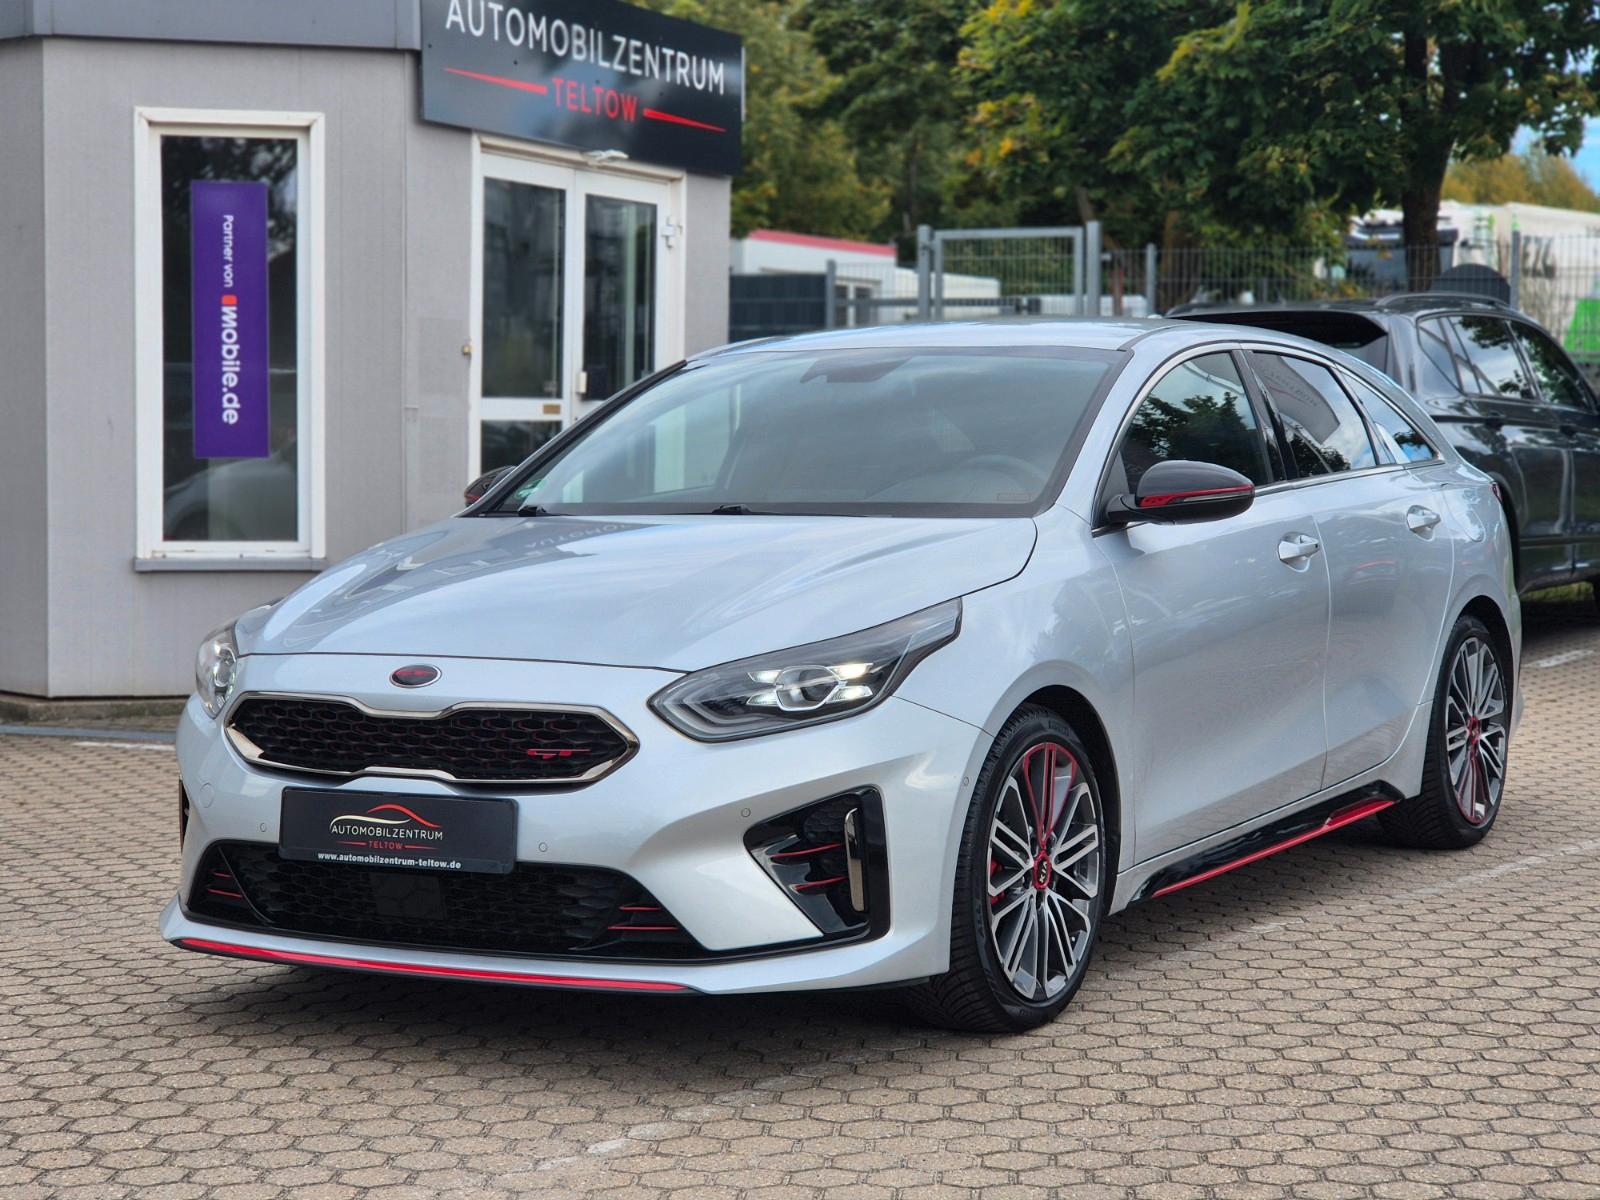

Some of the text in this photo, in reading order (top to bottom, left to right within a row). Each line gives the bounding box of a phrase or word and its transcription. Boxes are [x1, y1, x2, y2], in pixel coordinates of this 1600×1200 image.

[446, 0, 725, 95] AUTOMOBILZENTRUM
[552, 76, 639, 123] TELTOW
[222, 214, 235, 288] Partner von
[221, 306, 241, 425] mobile.de
[331, 825, 443, 841] AUTOMOBILZENTRUM
[368, 840, 403, 850] TELTOW
[317, 852, 462, 869] www.automobilzentrum-teltow.de
